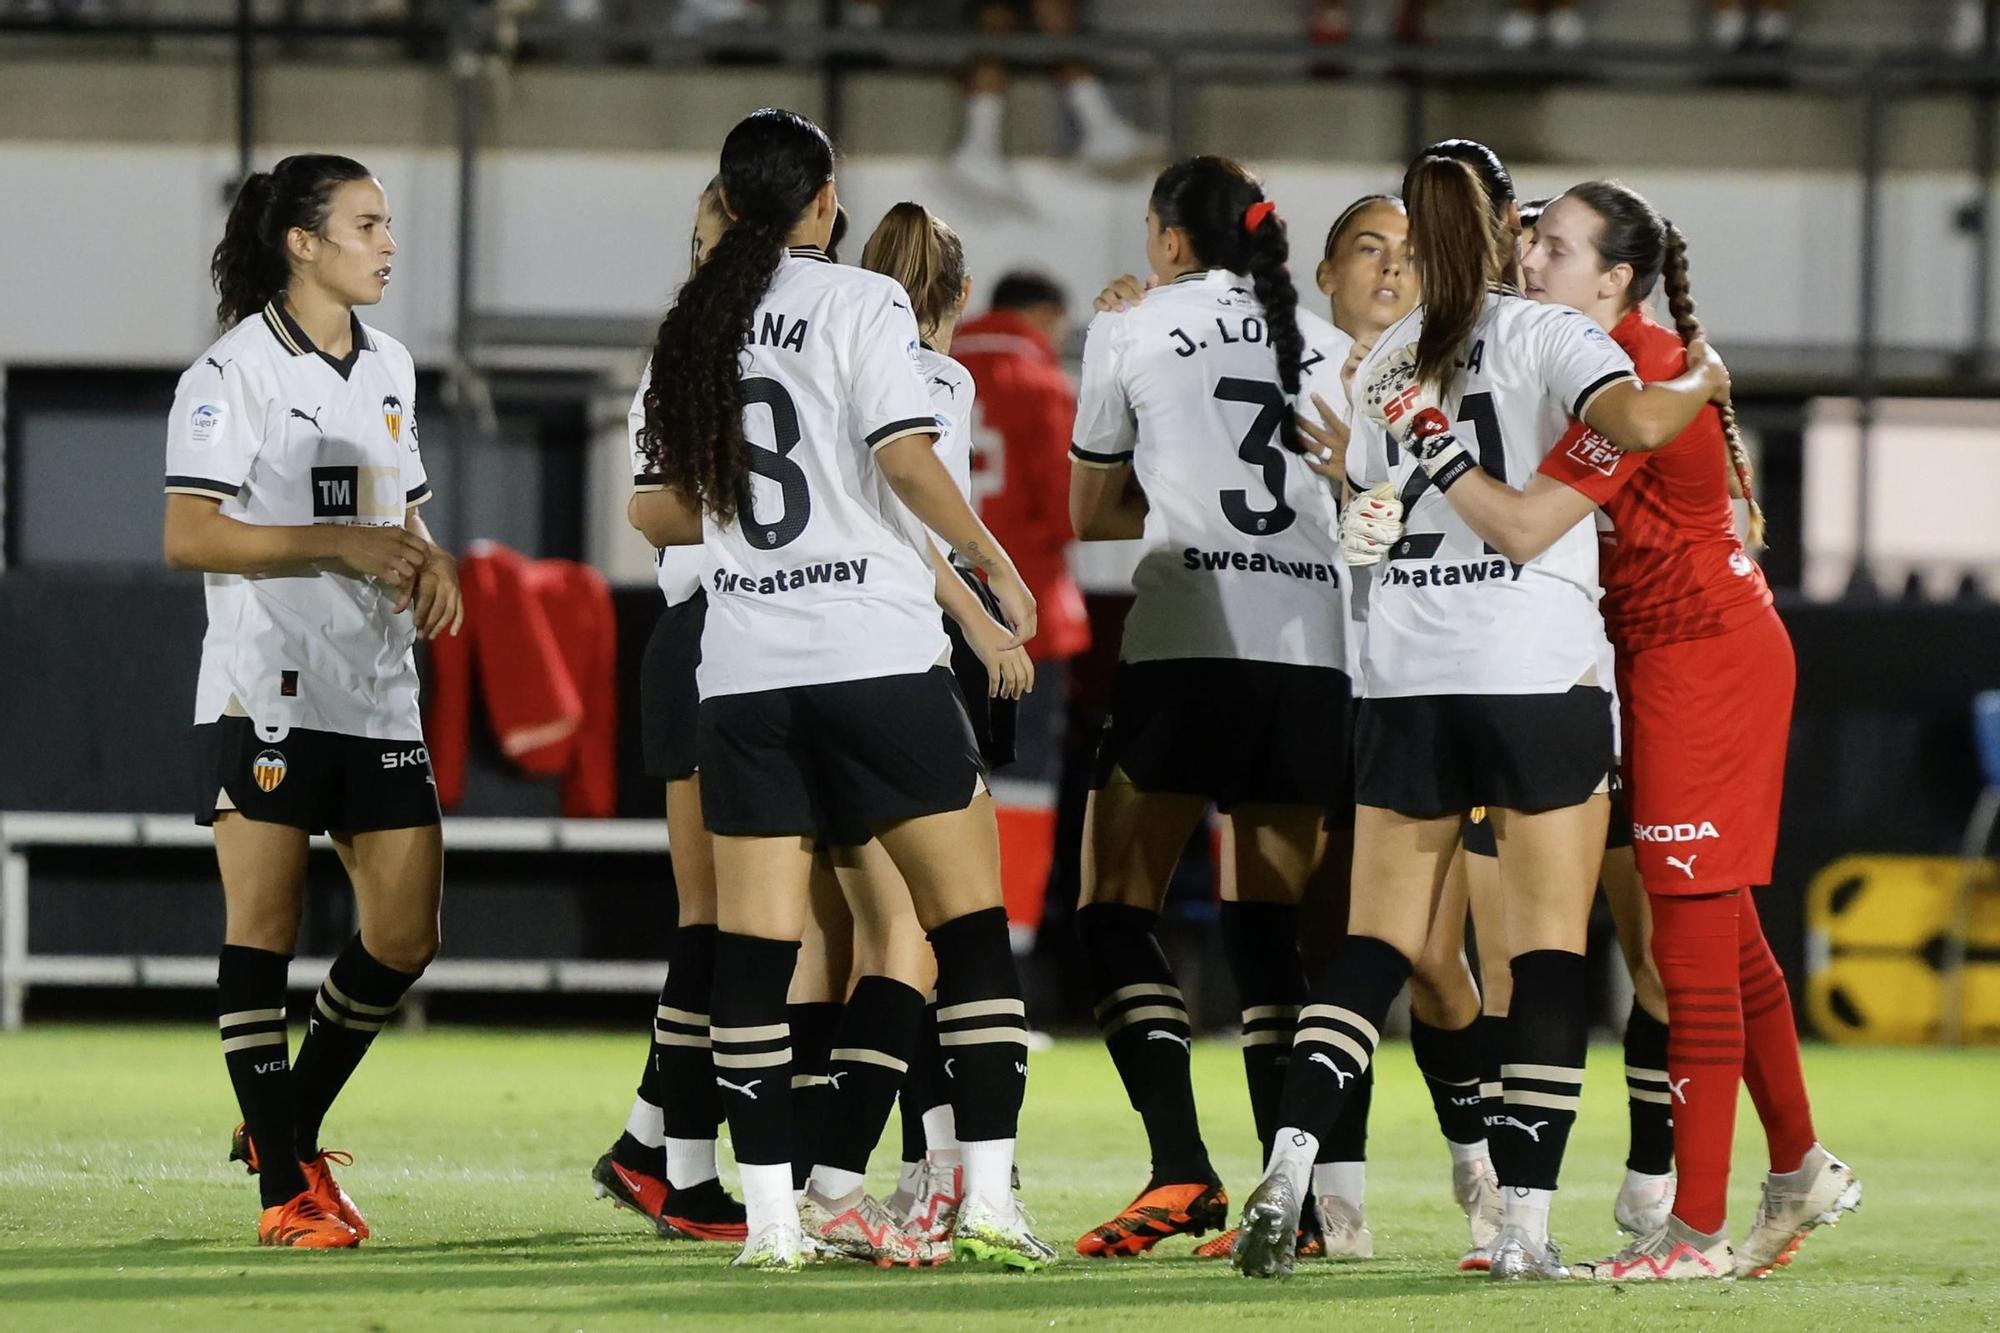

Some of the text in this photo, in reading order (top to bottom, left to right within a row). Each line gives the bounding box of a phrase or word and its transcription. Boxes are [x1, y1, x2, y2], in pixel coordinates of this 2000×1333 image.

[1169, 317, 1326, 376] J. LOZ
[736, 376, 811, 551] 8
[1213, 376, 1297, 536] 3
[318, 479, 351, 506] TM
[713, 558, 868, 595] Sweataway
[1183, 547, 1340, 589] Sweataway
[1633, 821, 1721, 842] SKODA
